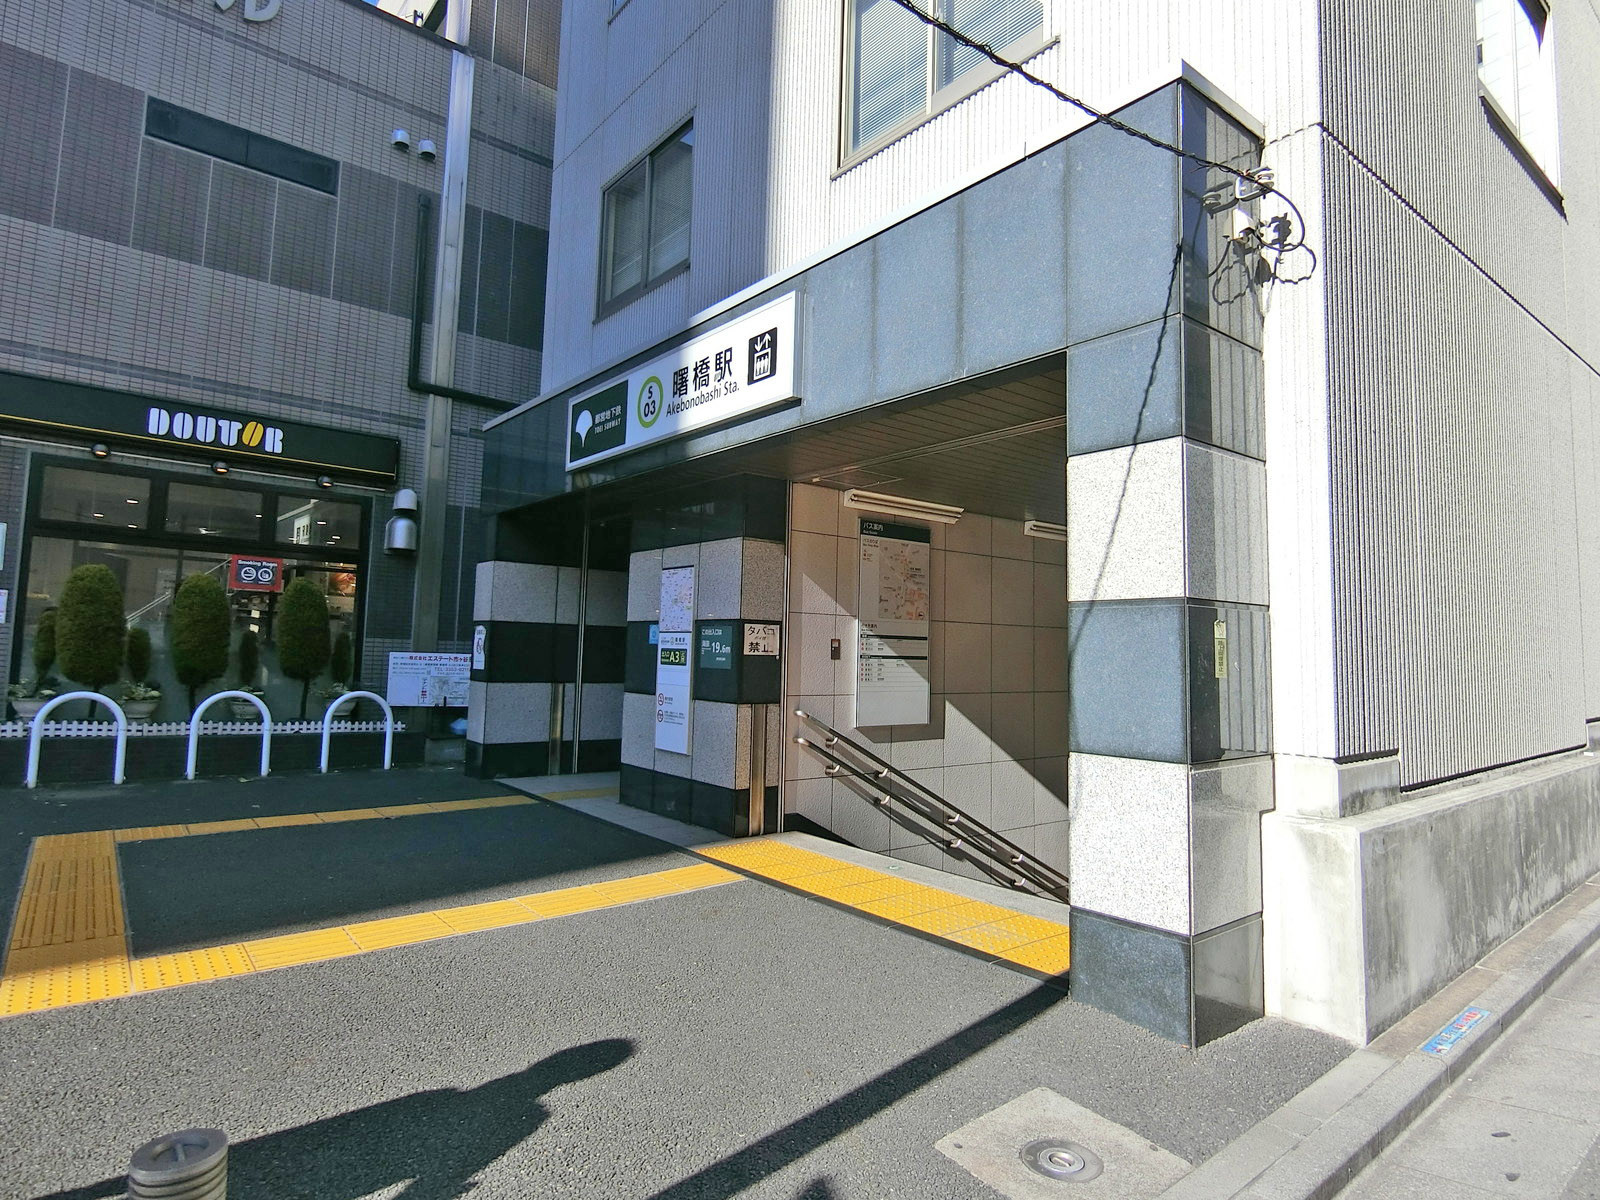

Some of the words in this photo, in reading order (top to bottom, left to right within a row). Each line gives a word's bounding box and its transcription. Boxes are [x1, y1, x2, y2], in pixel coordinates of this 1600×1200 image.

[672, 347, 733, 399] 曙橋駅
[666, 383, 722, 417] Akebonobashi
[724, 381, 740, 396] Sta.
[643, 400, 656, 418] 03
[148, 407, 284, 454] DOUTOR
[747, 626, 775, 636] タバコ
[711, 642, 731, 654] 19.6m
[748, 641, 774, 653] 禁止
[670, 651, 680, 663] A3
